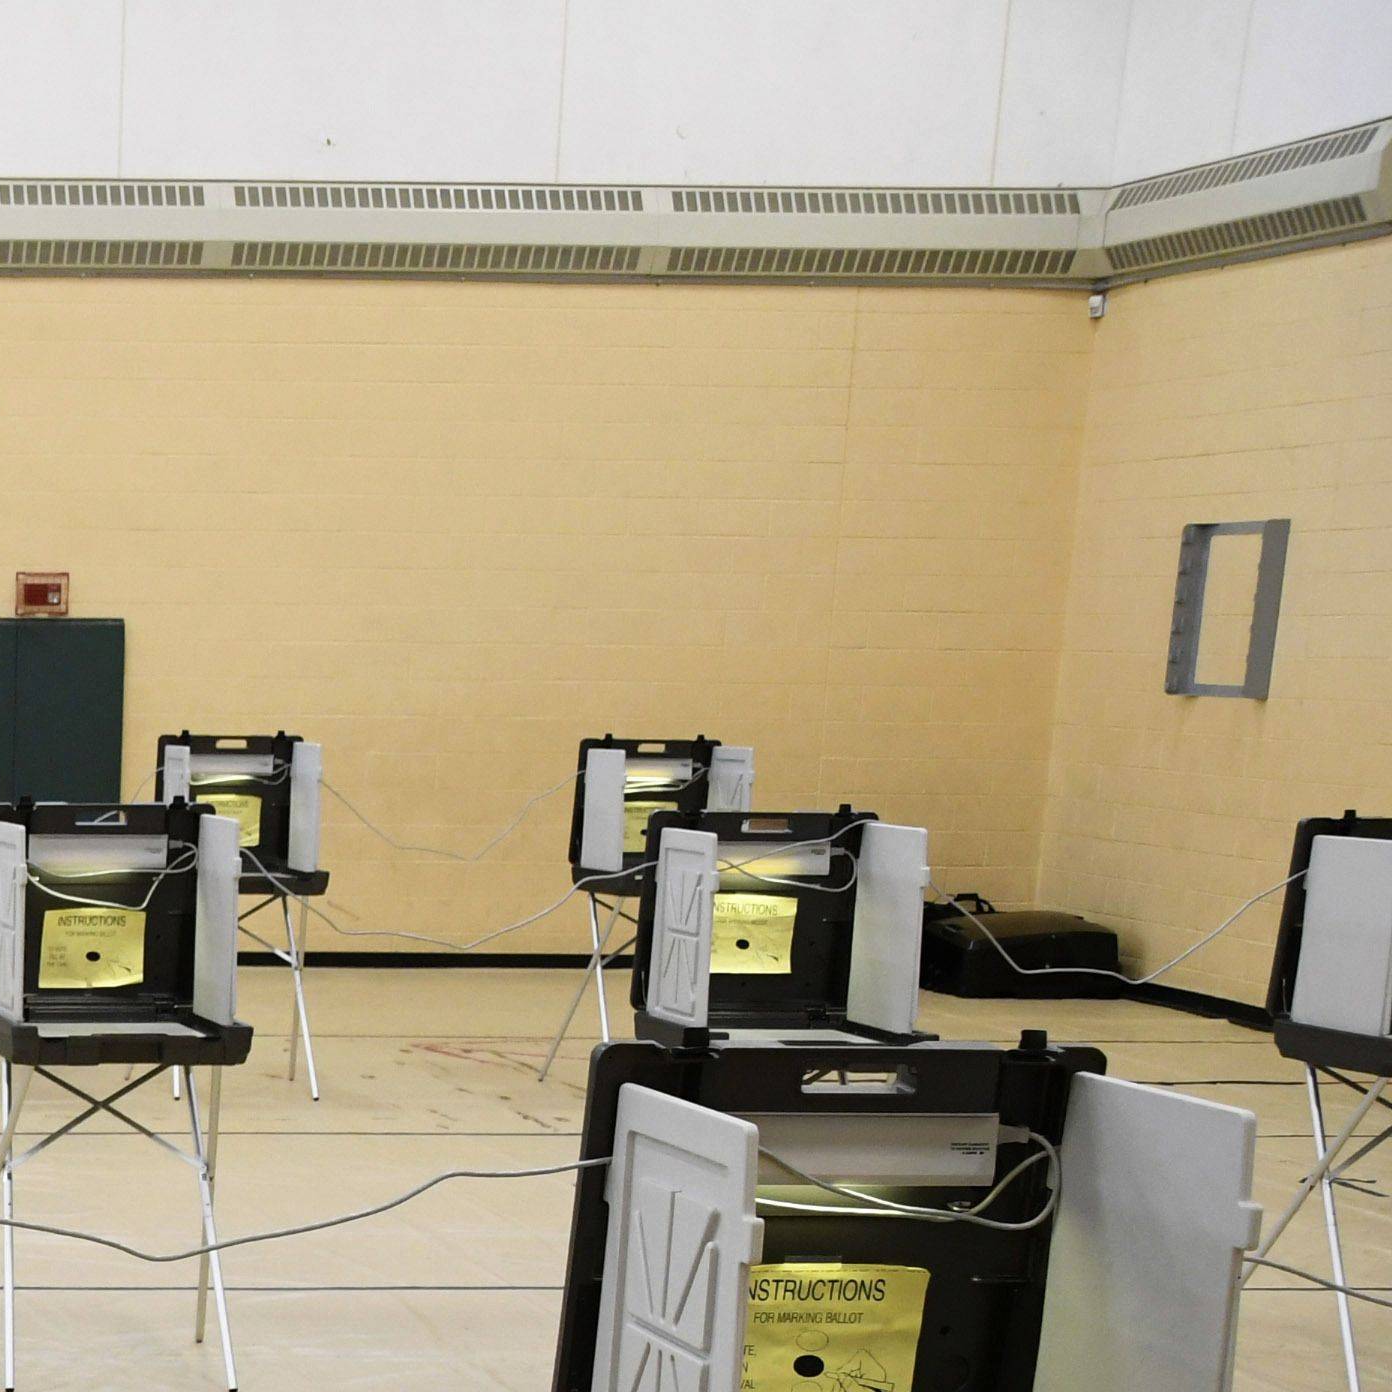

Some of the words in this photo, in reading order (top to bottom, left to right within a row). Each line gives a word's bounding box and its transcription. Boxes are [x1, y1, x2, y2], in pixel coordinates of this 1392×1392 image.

[714, 902, 778, 916] NSTRUCTIONS
[58, 915, 127, 927] INSTRUCTIONS
[749, 1279, 886, 1301] NSTRUCTIONS
[753, 1312, 775, 1324] FOR
[777, 1312, 822, 1324] MARKING
[825, 1312, 864, 1324] BALLOT
